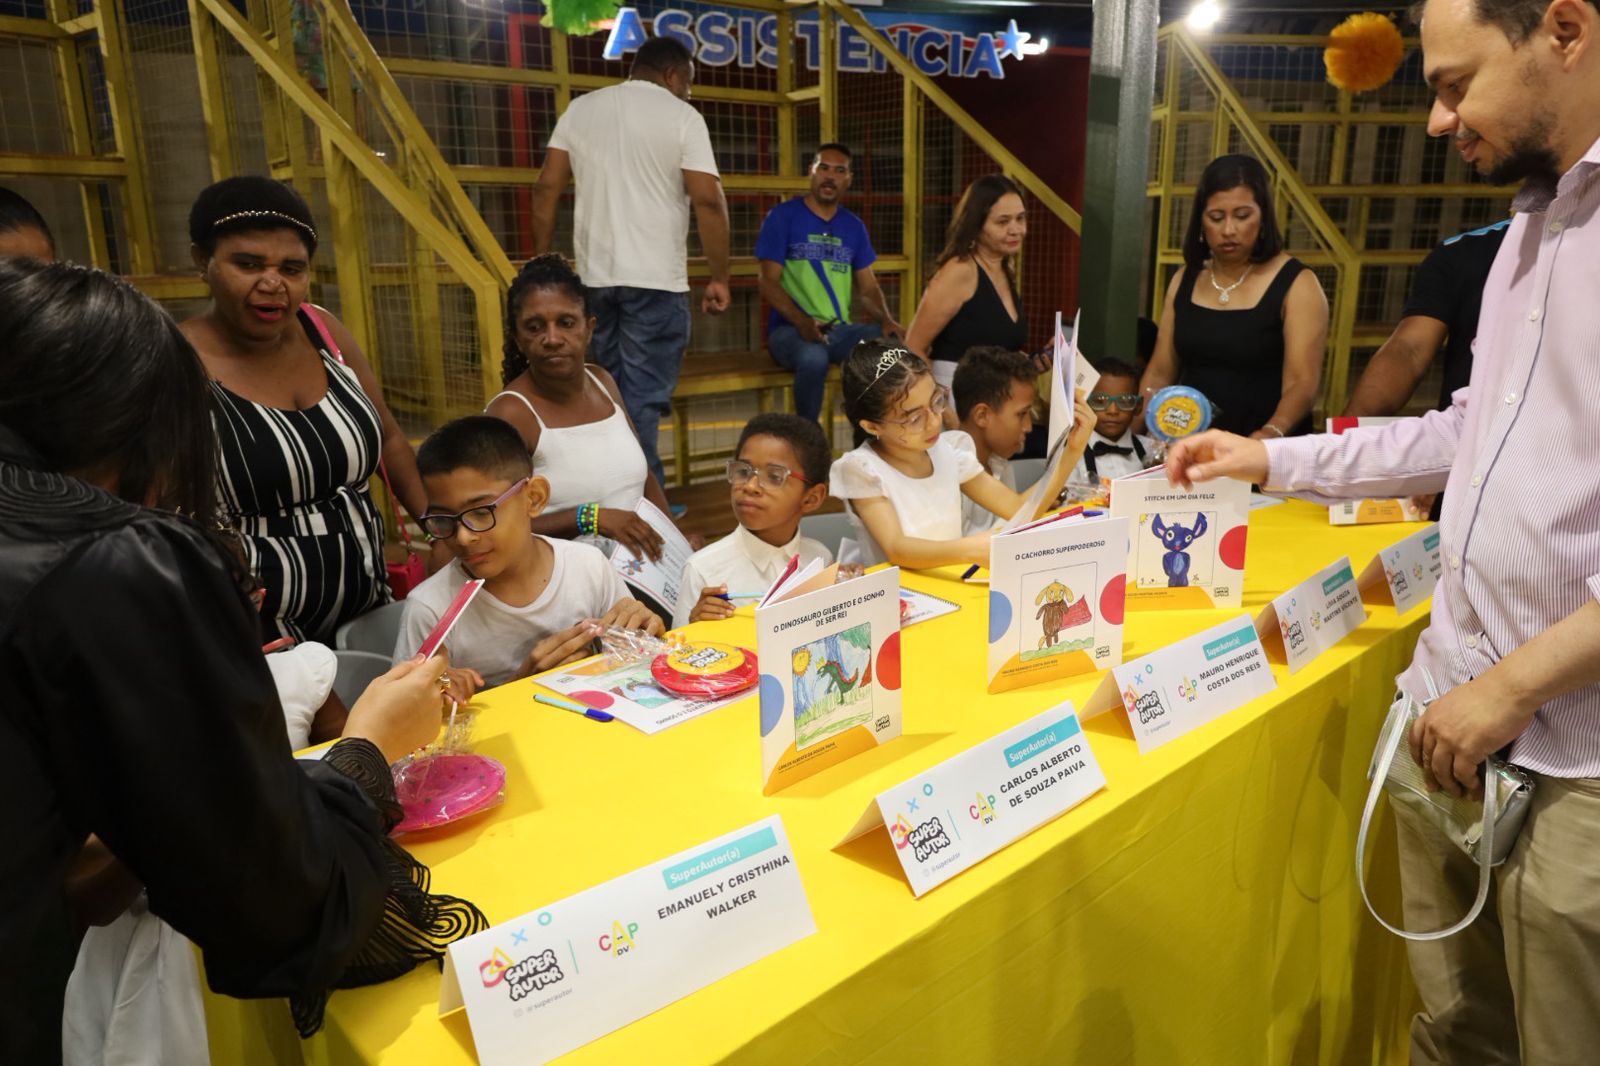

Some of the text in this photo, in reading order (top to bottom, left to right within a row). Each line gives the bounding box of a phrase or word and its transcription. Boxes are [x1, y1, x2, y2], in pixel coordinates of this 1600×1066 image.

[1176, 493, 1187, 501] UM
[1015, 540, 1105, 561] O CACHORRO SUPERPODEROSO
[773, 625, 780, 633] O
[780, 610, 822, 631] DINOSSAURO
[822, 600, 852, 616] GILBERTO
[852, 598, 857, 606] E
[863, 589, 885, 602] SONHO
[815, 610, 848, 627] DE SER REI
[1199, 648, 1259, 680] MAURO HENRIQUE
[1207, 661, 1261, 692] COSTA DOS REIS
[1000, 744, 1081, 793] CARLOS ALBERTO
[1009, 760, 1086, 808] DE SOUZA PAIVA
[908, 816, 943, 848] SUPER
[914, 832, 951, 863] AUTOR
[670, 847, 741, 883] SuperAutor(a)
[657, 855, 790, 919] EMANUELY CRISTHINA
[706, 889, 757, 919] WALKER
[599, 920, 639, 958] CAP
[616, 945, 630, 956] DV
[504, 949, 557, 985] SUPER
[510, 965, 564, 1001] AUTOR
